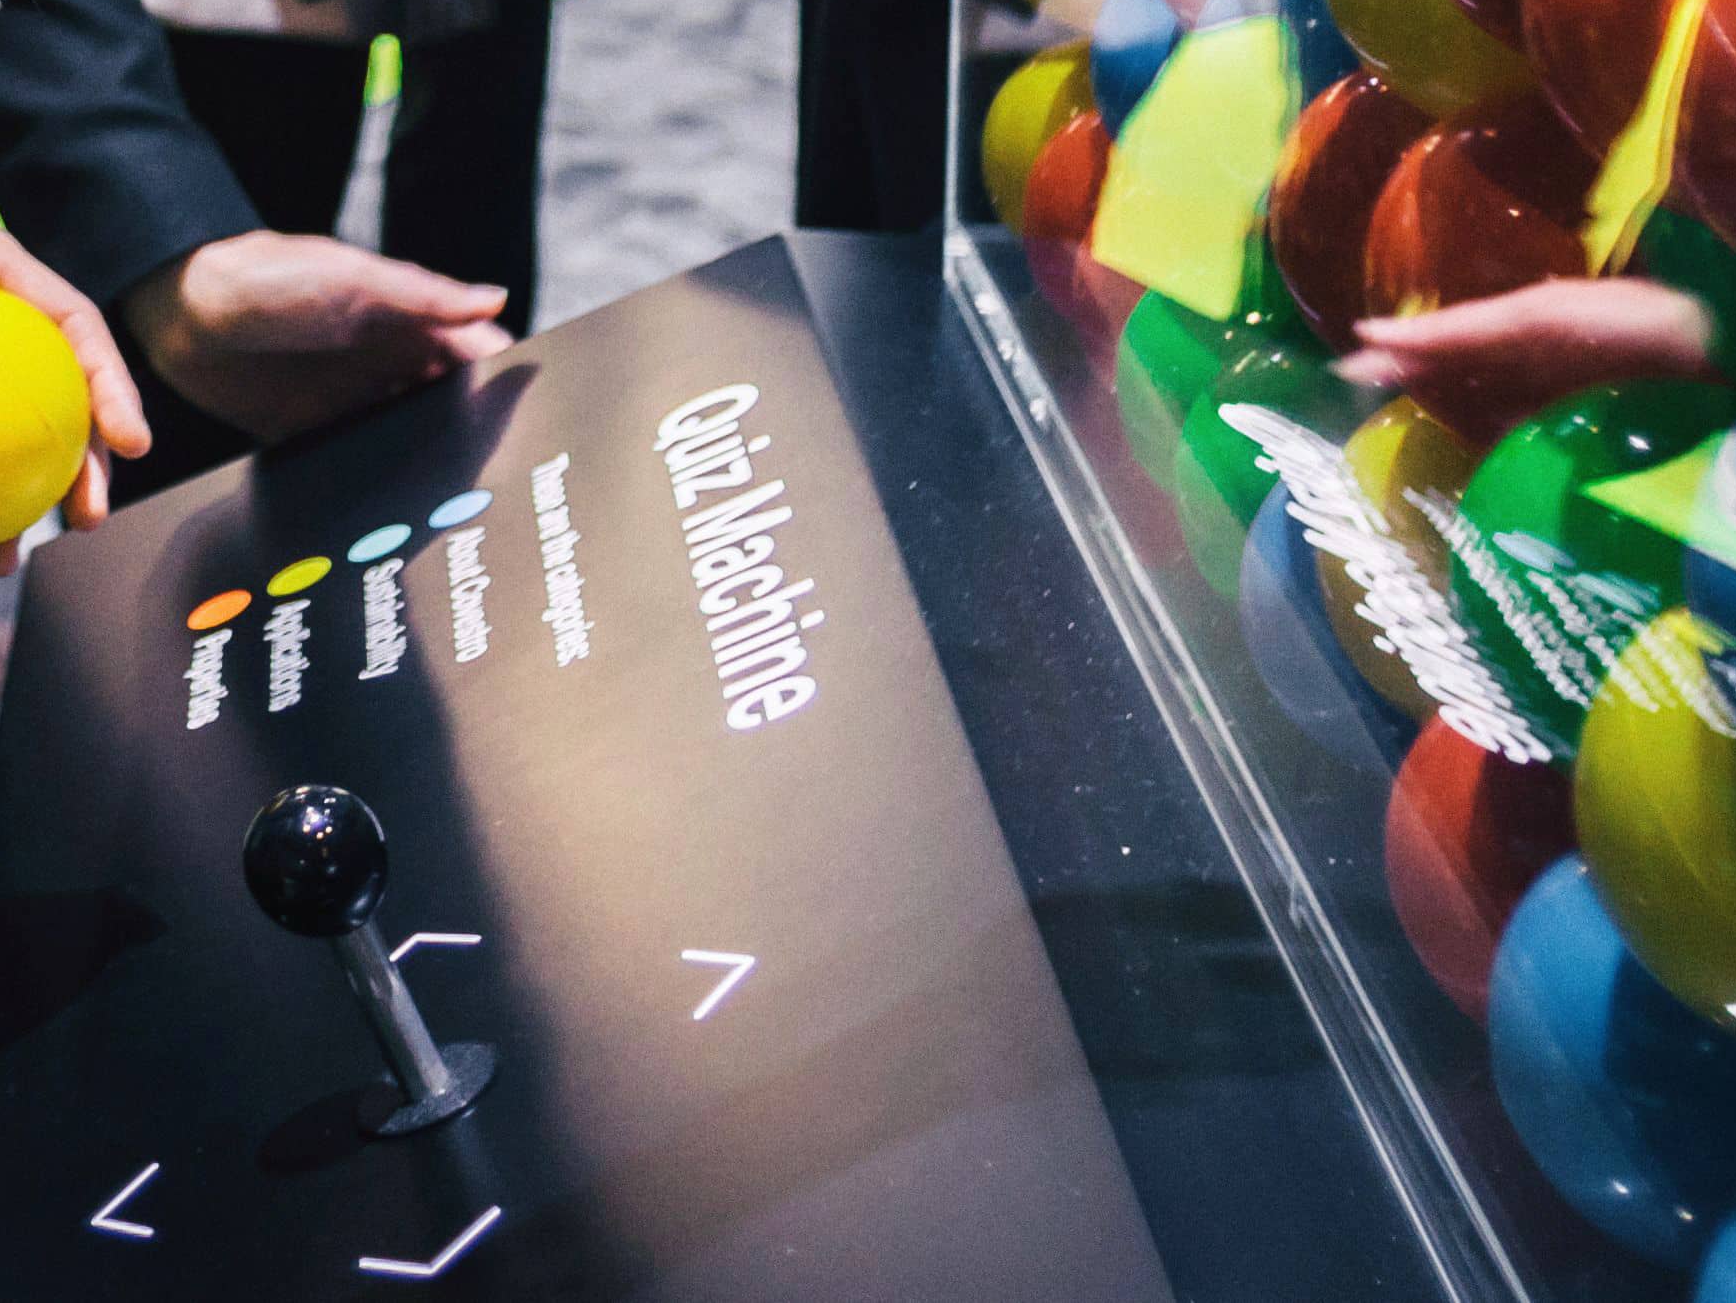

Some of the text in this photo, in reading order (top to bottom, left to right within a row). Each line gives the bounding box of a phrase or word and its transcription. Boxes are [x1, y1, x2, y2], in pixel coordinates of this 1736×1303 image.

[541, 530, 582, 570] the
[653, 383, 825, 730] Quiz Machine
[263, 598, 311, 713] Applications
[357, 557, 407, 680] Sustainability
[541, 562, 596, 668] categories:
[182, 628, 233, 730] Properties
